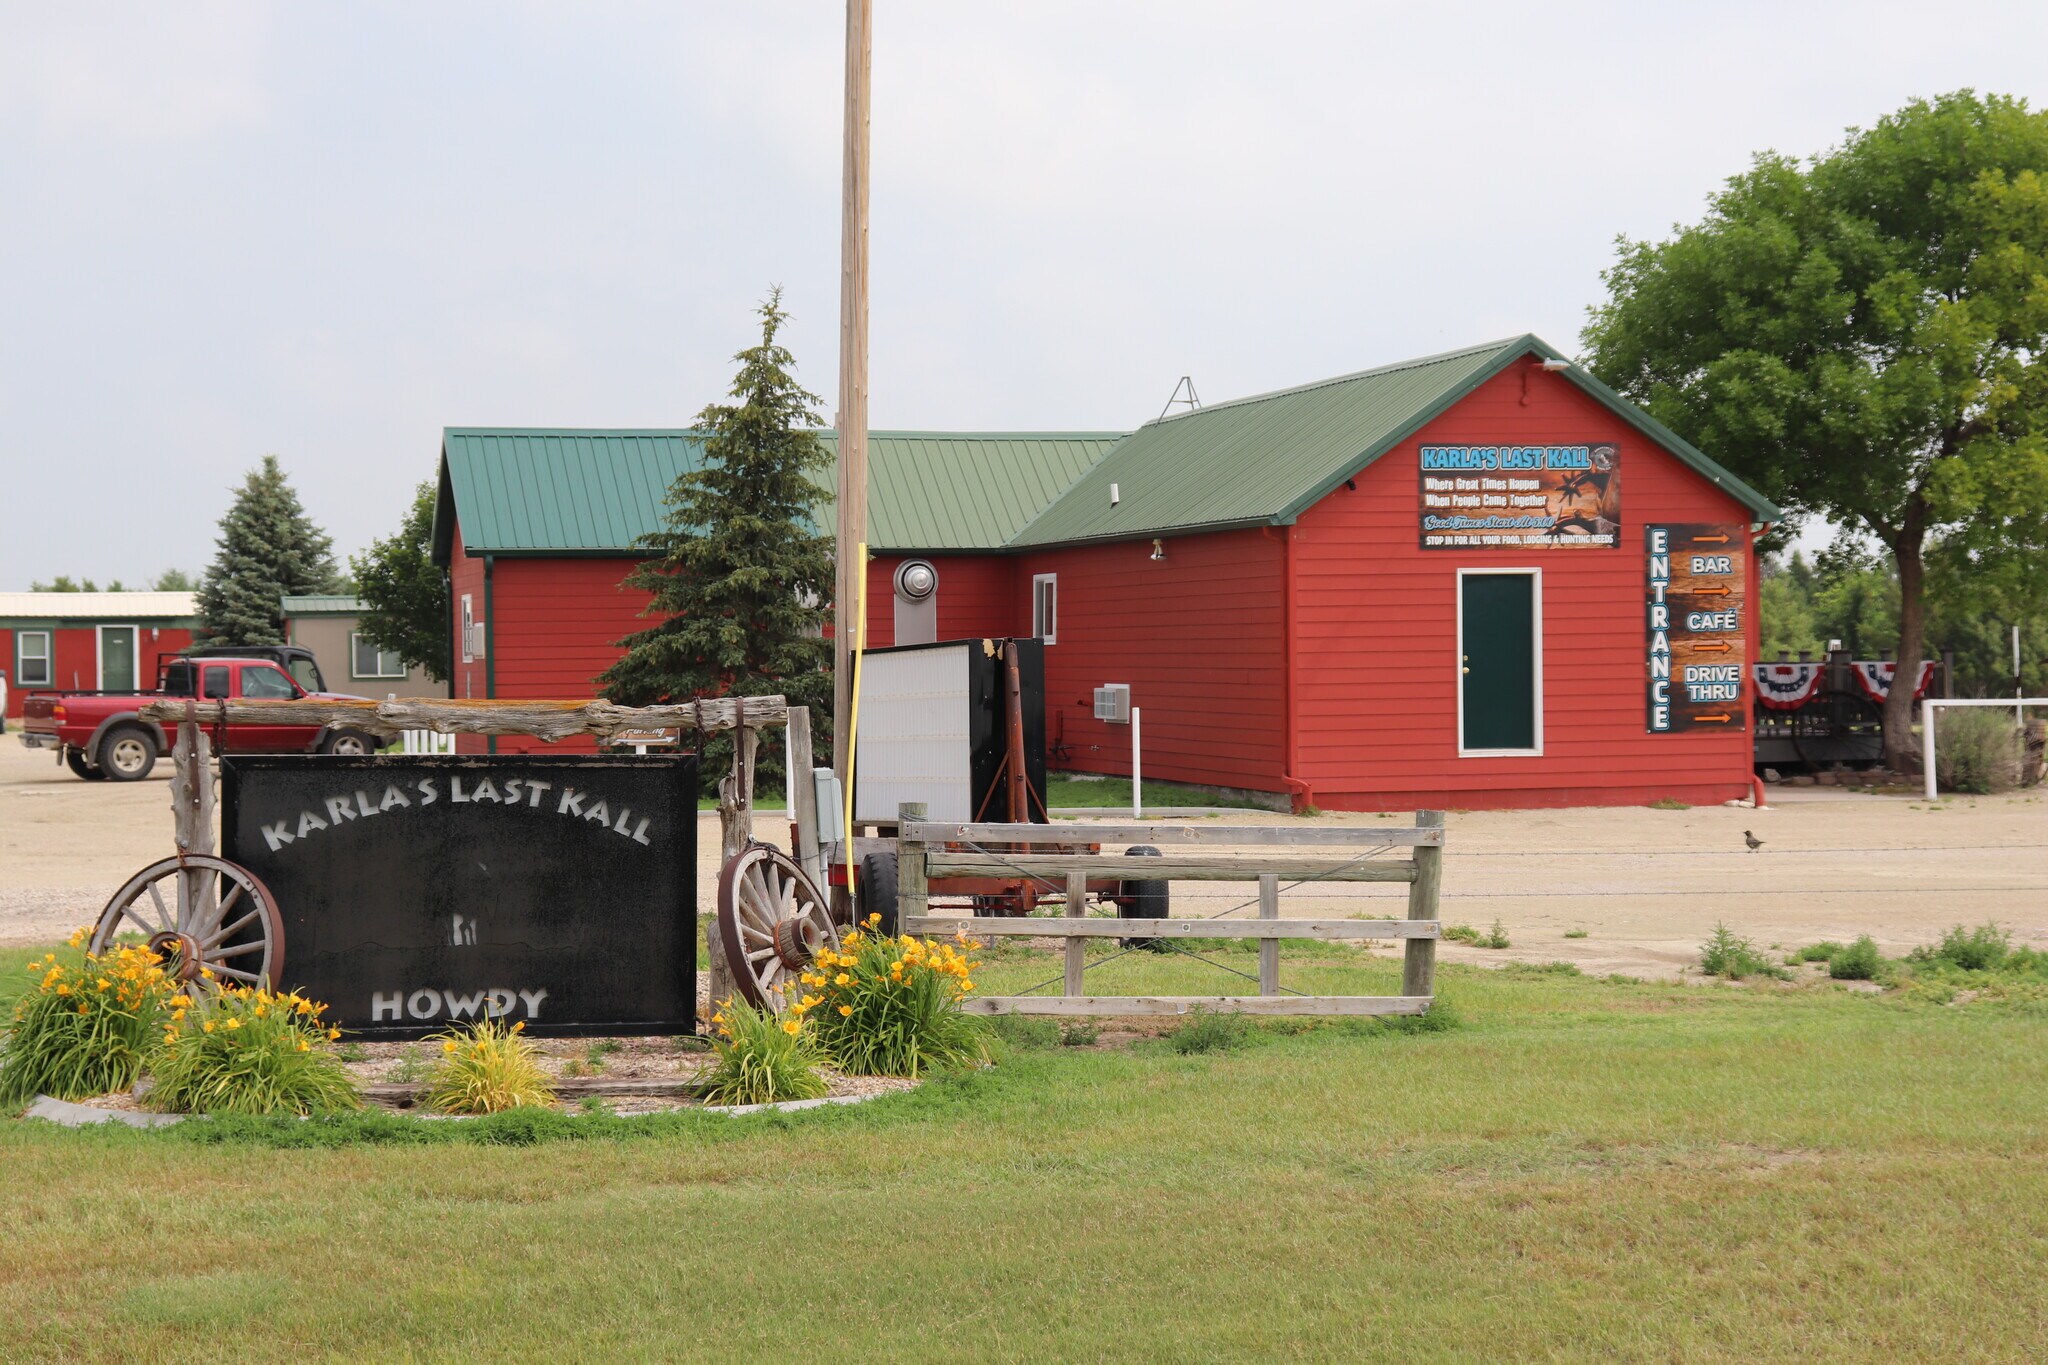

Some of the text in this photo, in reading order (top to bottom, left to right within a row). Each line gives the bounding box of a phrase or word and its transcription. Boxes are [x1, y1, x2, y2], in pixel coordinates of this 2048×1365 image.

[1422, 447, 1499, 470] KARLA'S
[1500, 447, 1546, 470] LAST
[1546, 447, 1592, 470] KALL
[1425, 477, 1540, 491] Where Great Times Happen
[1425, 493, 1547, 508] When People Come Together
[1424, 515, 1453, 530] Good
[1452, 515, 1485, 530] Times
[1485, 515, 1514, 529] Start
[1514, 515, 1532, 529] At
[1426, 534, 1614, 546] STOP IN FOR ALL YOUR FOOD, LODGING & HUNTING NEEDS
[1691, 557, 1732, 574] BAR
[1687, 610, 1738, 630] CAFÉ
[1651, 530, 1670, 730] ENTRANCE
[1685, 666, 1740, 682] DRIVE
[1688, 682, 1739, 701] THRU
[451, 776, 551, 807] LAST
[557, 787, 651, 846] KALL
[372, 988, 548, 1021] HOWDY
